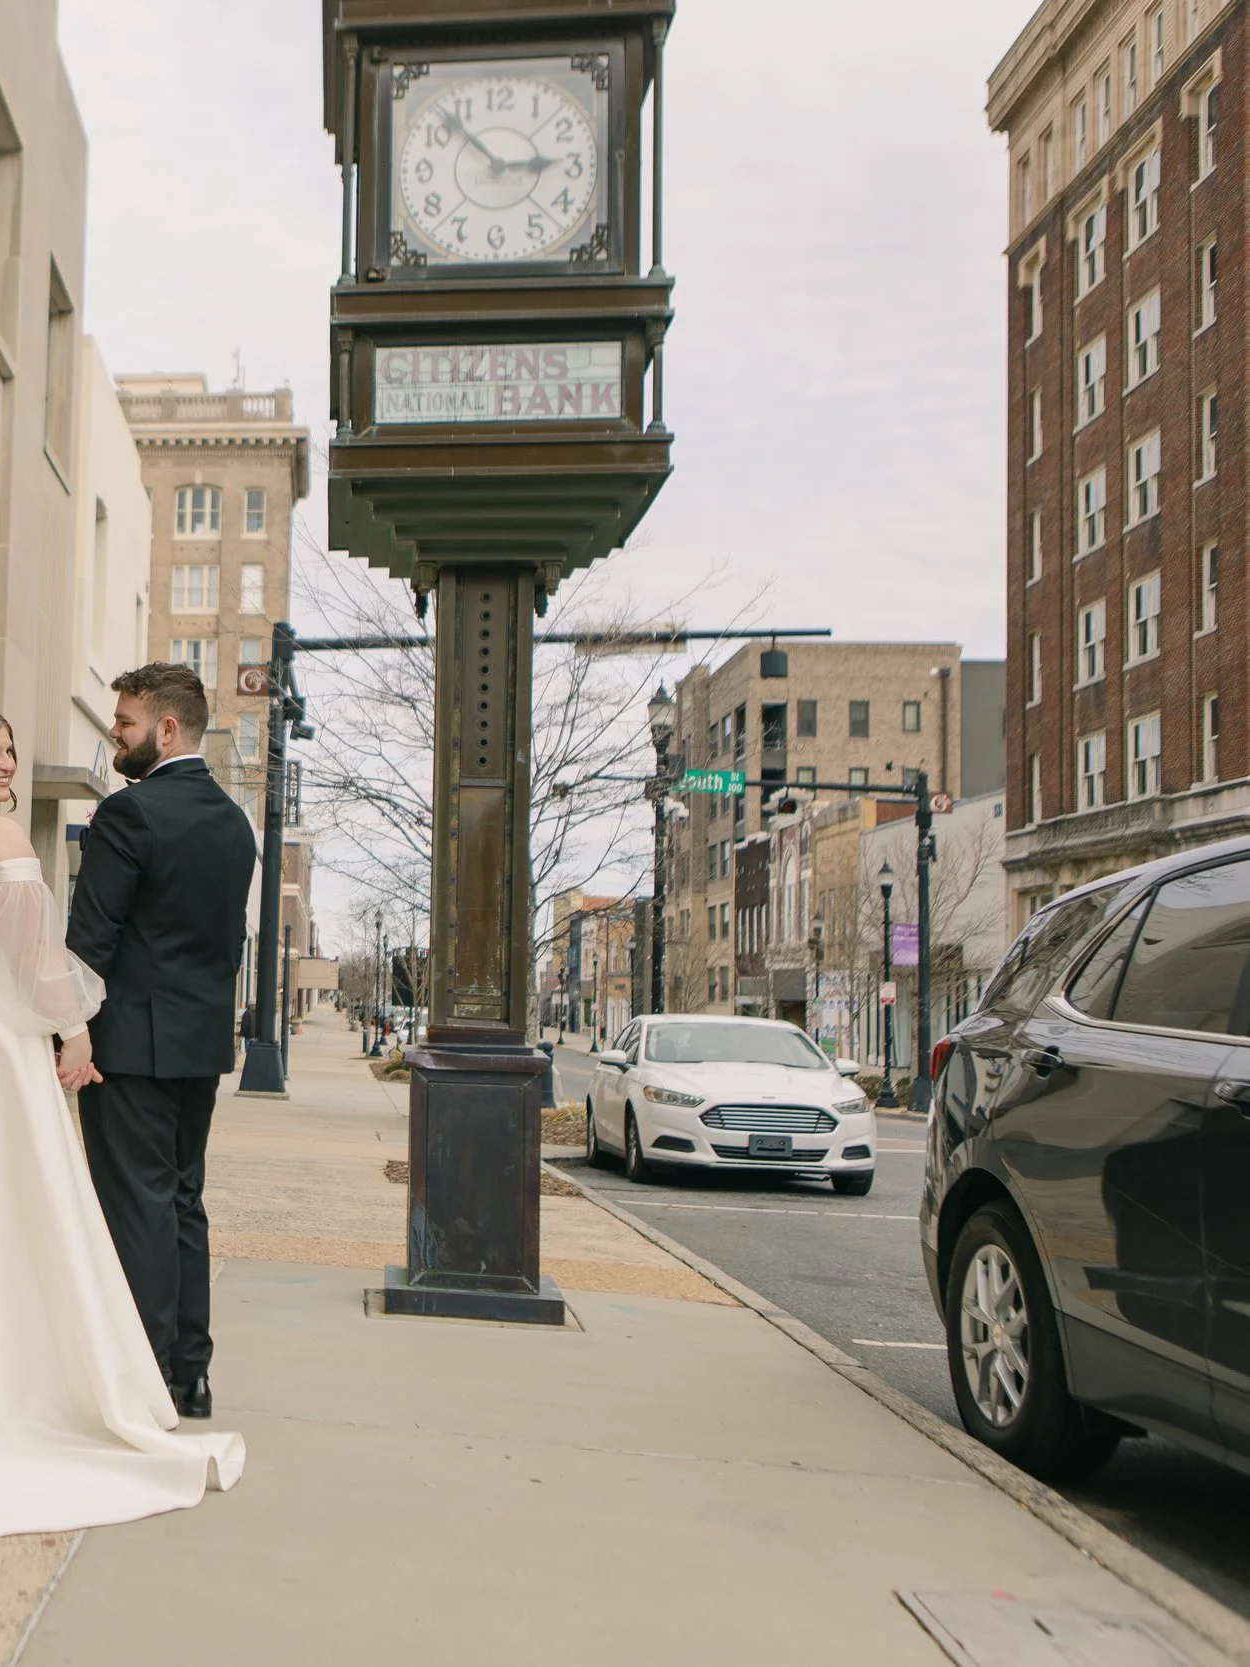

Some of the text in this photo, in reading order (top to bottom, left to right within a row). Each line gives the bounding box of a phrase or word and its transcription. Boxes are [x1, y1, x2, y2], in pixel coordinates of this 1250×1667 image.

[454, 97, 472, 121] 11
[486, 86, 515, 111] 12
[426, 123, 452, 148] 10
[555, 117, 574, 143] 2
[415, 157, 434, 184] 9
[565, 152, 582, 179] 3
[424, 191, 442, 217] 8
[551, 186, 575, 214] 4
[451, 216, 469, 243] 7
[487, 224, 505, 250] 6
[526, 213, 544, 239] 5
[381, 349, 568, 384] CITIZENS
[387, 383, 617, 416] NATIONAL BANK
